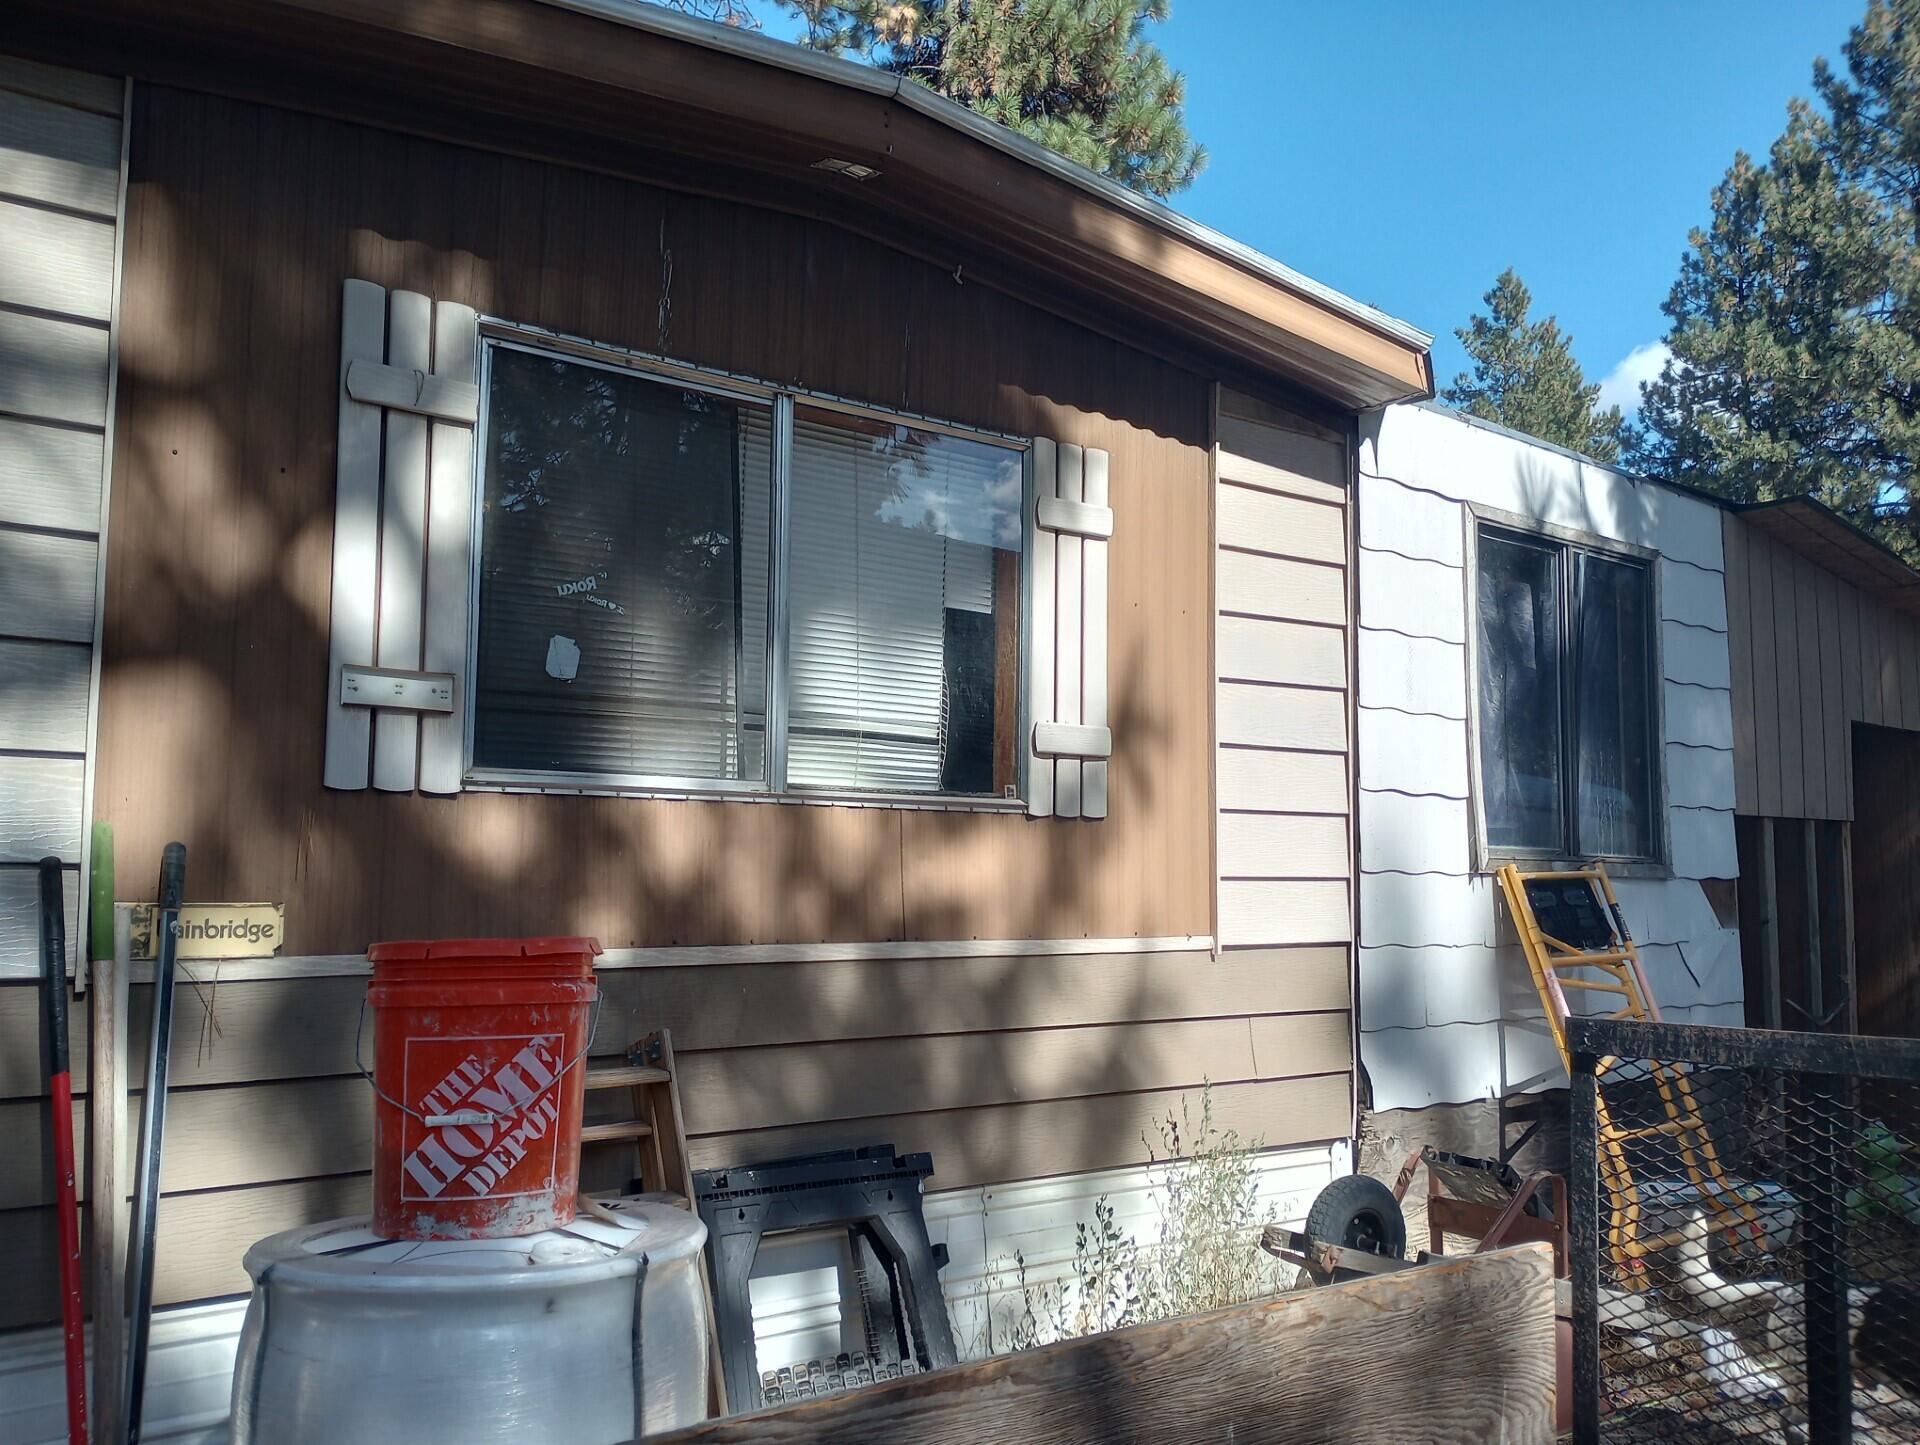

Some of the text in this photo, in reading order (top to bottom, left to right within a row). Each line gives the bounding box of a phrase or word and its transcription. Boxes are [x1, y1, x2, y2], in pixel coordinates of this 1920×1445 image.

[157, 918, 275, 944] ainbridge
[404, 1036, 563, 1198] HOME
[418, 1054, 490, 1117] THE
[462, 1093, 558, 1196] DEPOT
